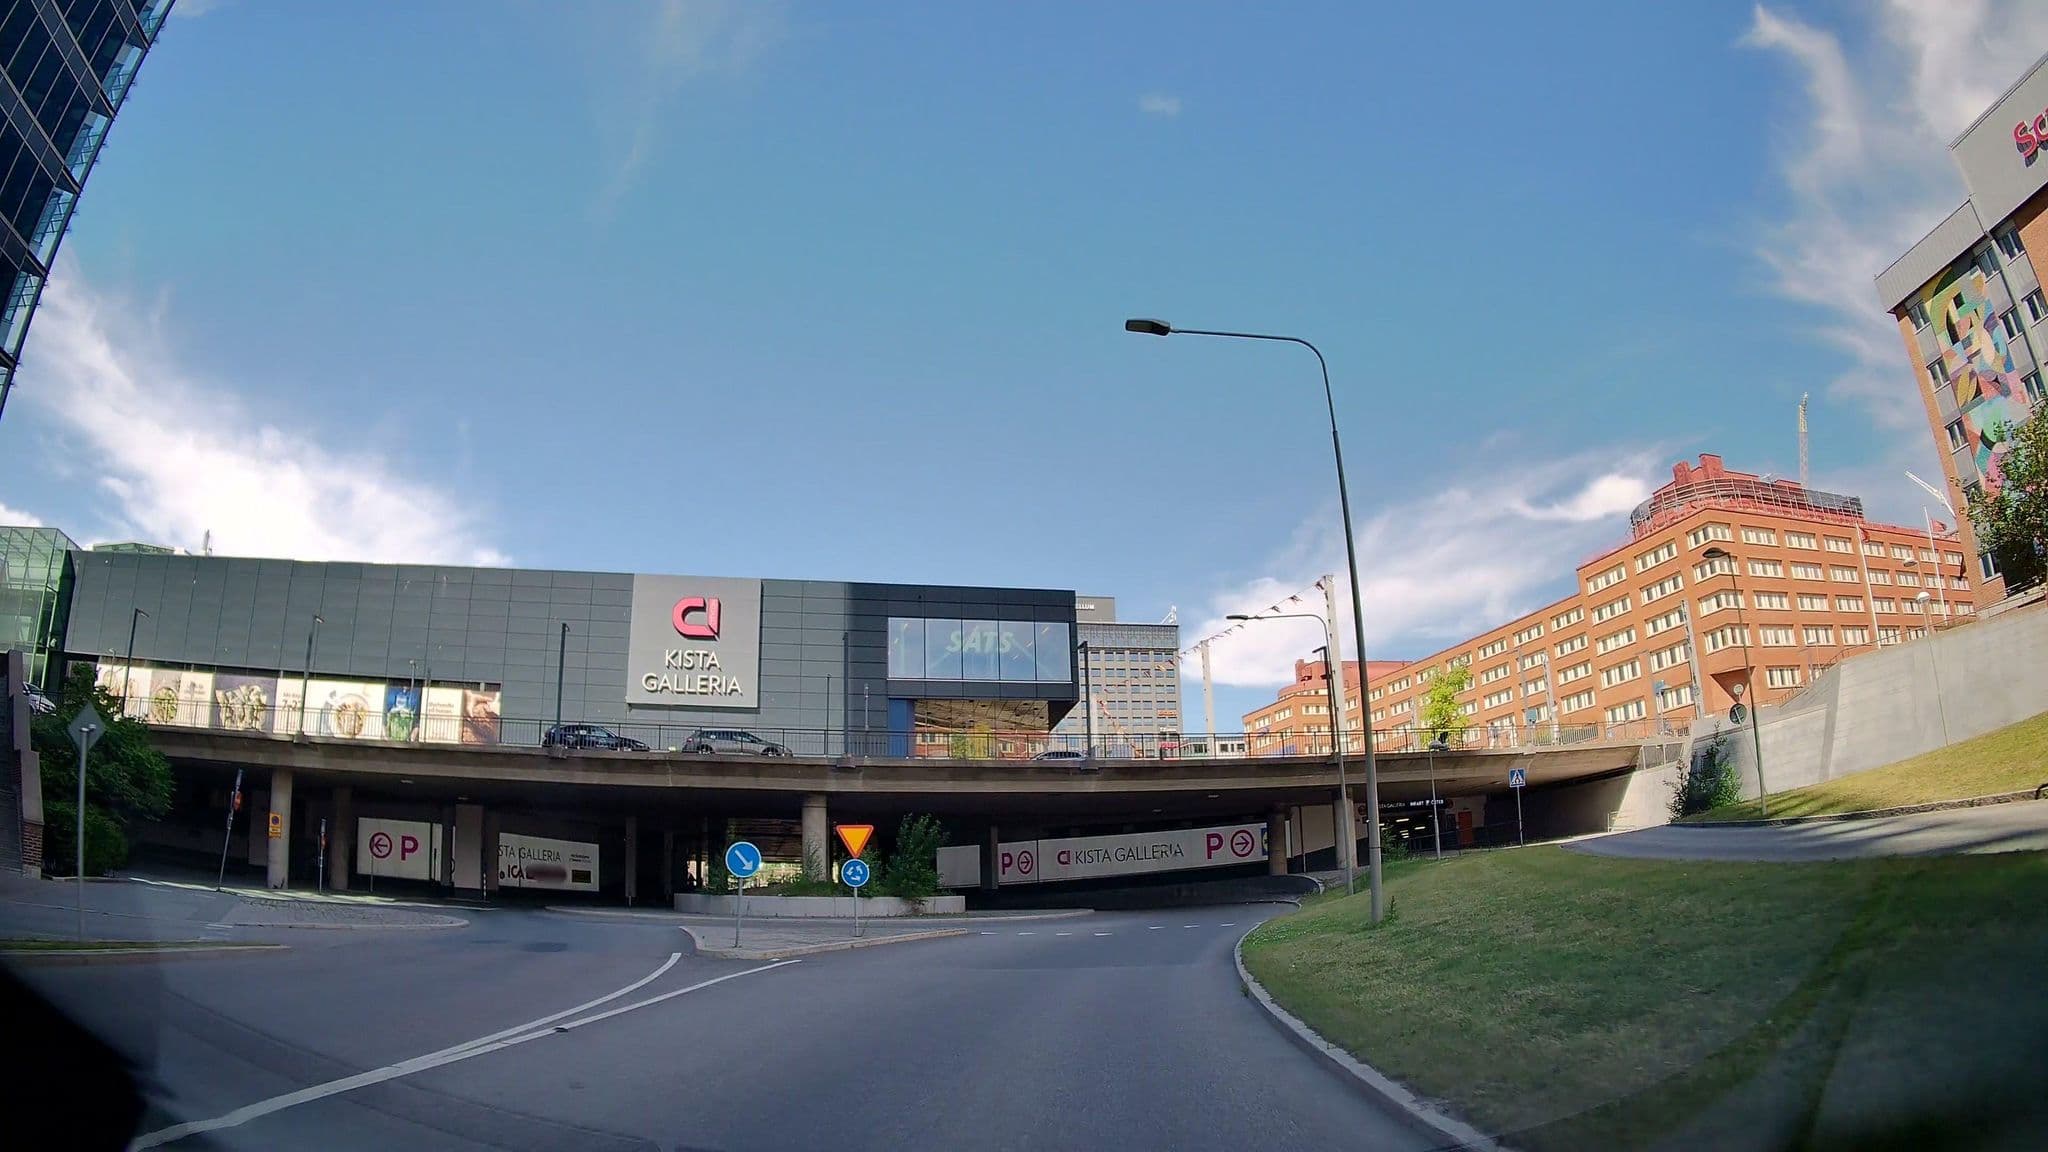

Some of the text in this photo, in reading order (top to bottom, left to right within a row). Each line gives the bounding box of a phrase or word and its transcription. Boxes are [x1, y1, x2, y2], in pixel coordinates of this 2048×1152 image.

[946, 625, 1015, 654] SATS
[665, 648, 721, 670] KISTA
[642, 673, 742, 694] GALLERIA
[401, 835, 419, 861] P
[498, 844, 516, 858] STA
[519, 846, 561, 862] GALLERIA
[1075, 843, 1184, 865] KISTA GALLERIA
[1205, 833, 1224, 860] P
[507, 864, 525, 880] ICA
[1001, 852, 1013, 876] P
